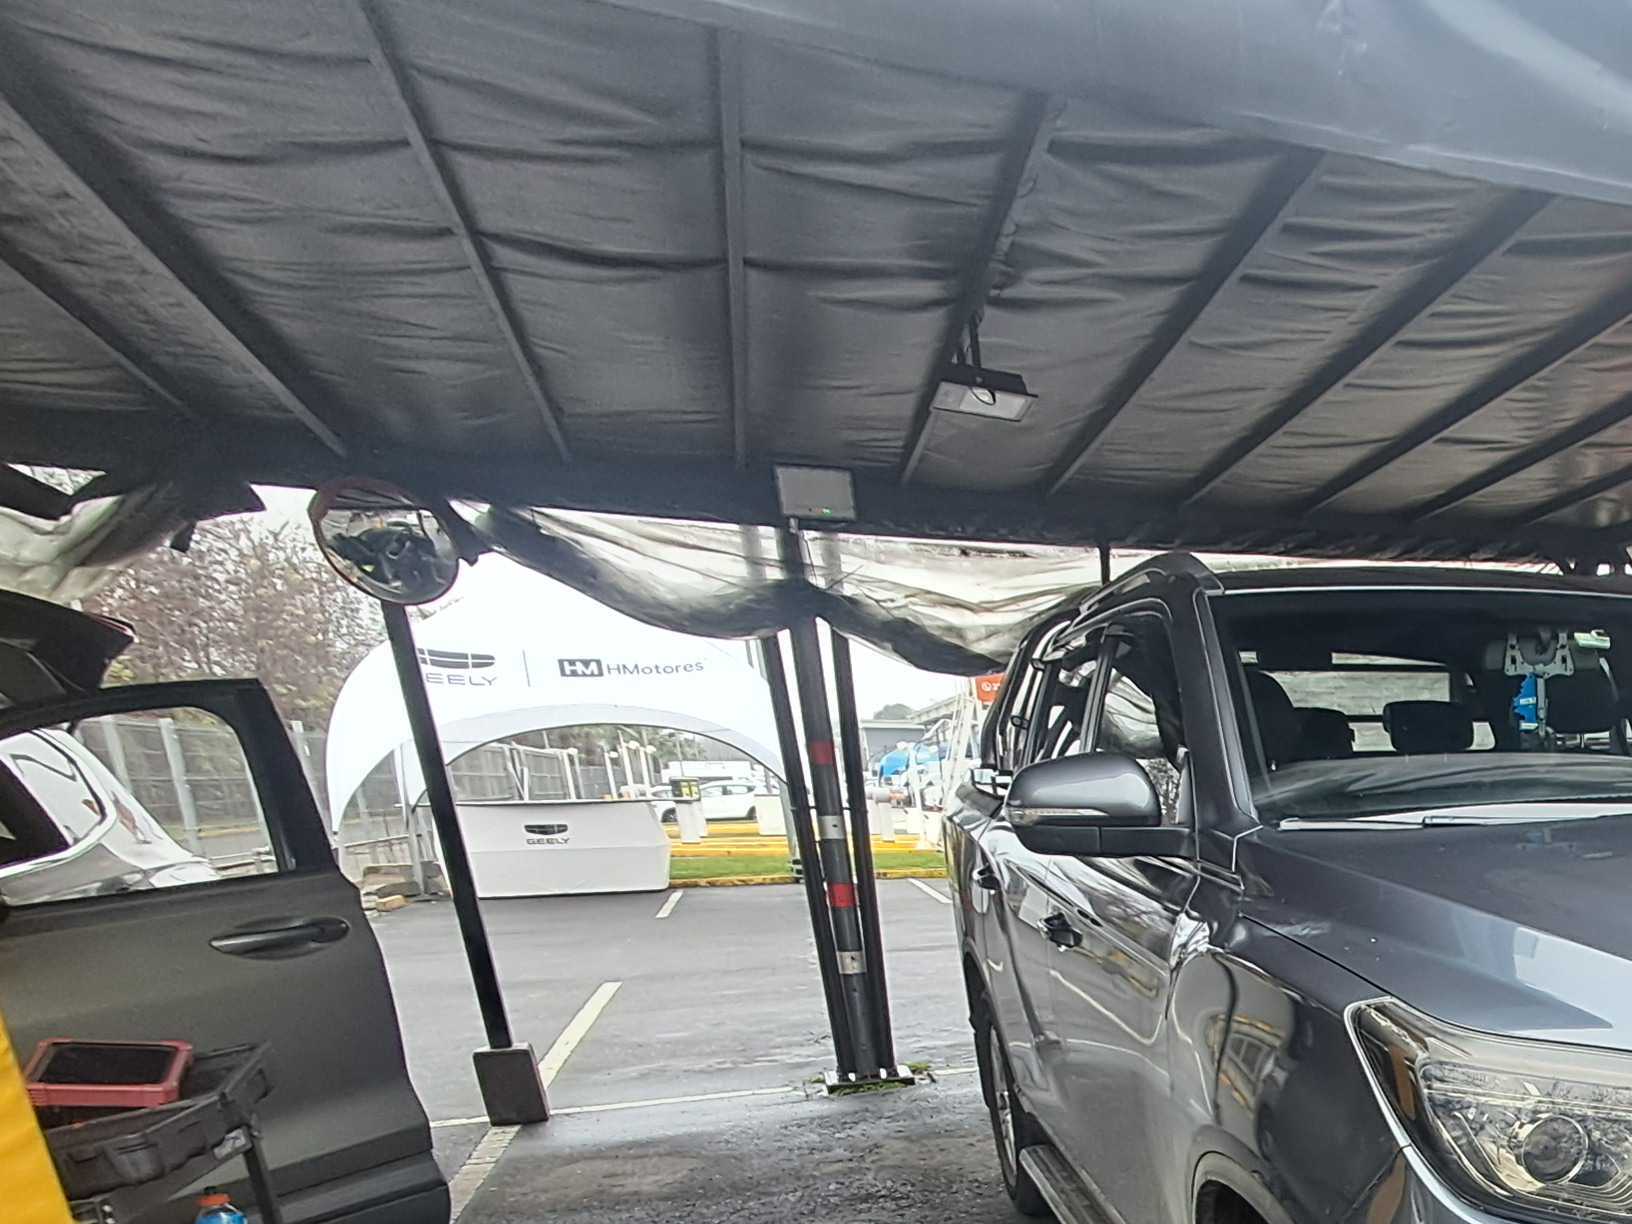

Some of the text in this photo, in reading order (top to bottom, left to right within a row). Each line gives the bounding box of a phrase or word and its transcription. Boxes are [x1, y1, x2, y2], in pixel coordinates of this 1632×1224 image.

[562, 660, 704, 676] HM HMotores
[424, 672, 498, 686] EELY
[526, 837, 570, 845] GEELY
